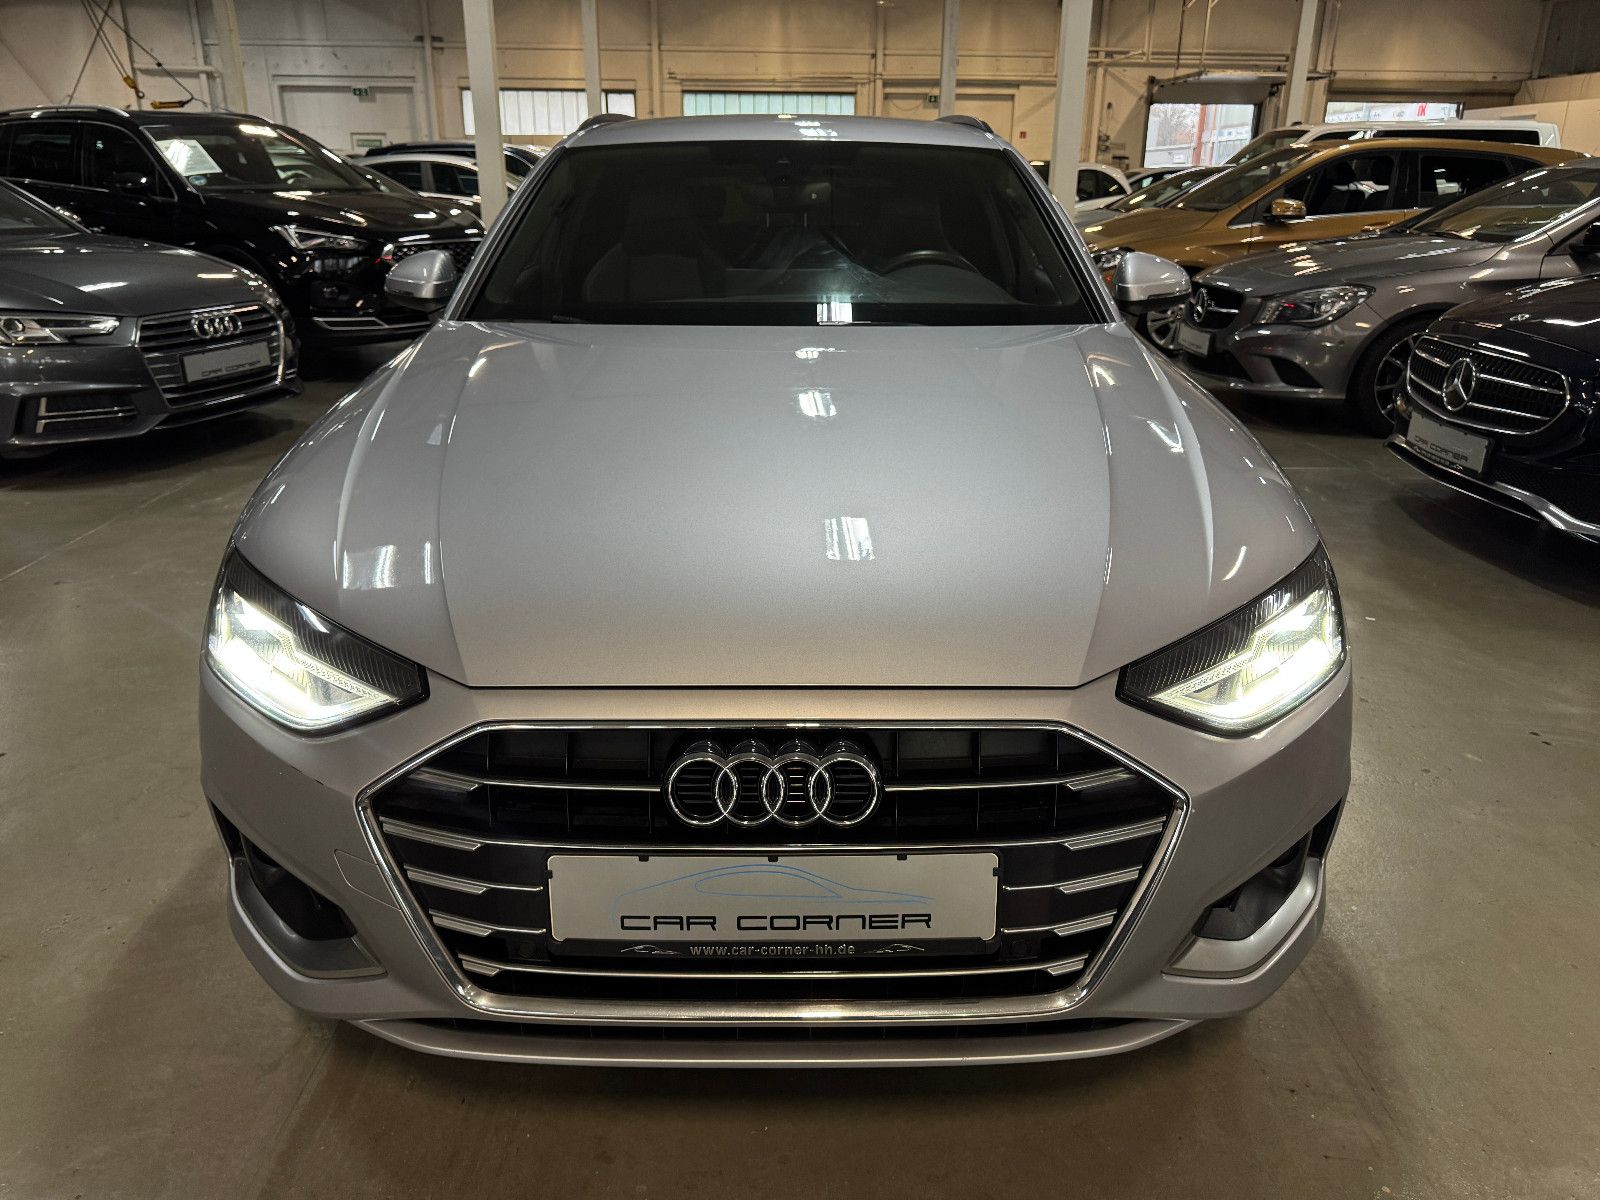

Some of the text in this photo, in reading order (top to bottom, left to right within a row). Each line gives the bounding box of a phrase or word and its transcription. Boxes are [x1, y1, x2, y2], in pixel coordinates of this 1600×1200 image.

[620, 913, 932, 931] CAR CORNER
[689, 944, 855, 956] www.car-corner-hh.de
